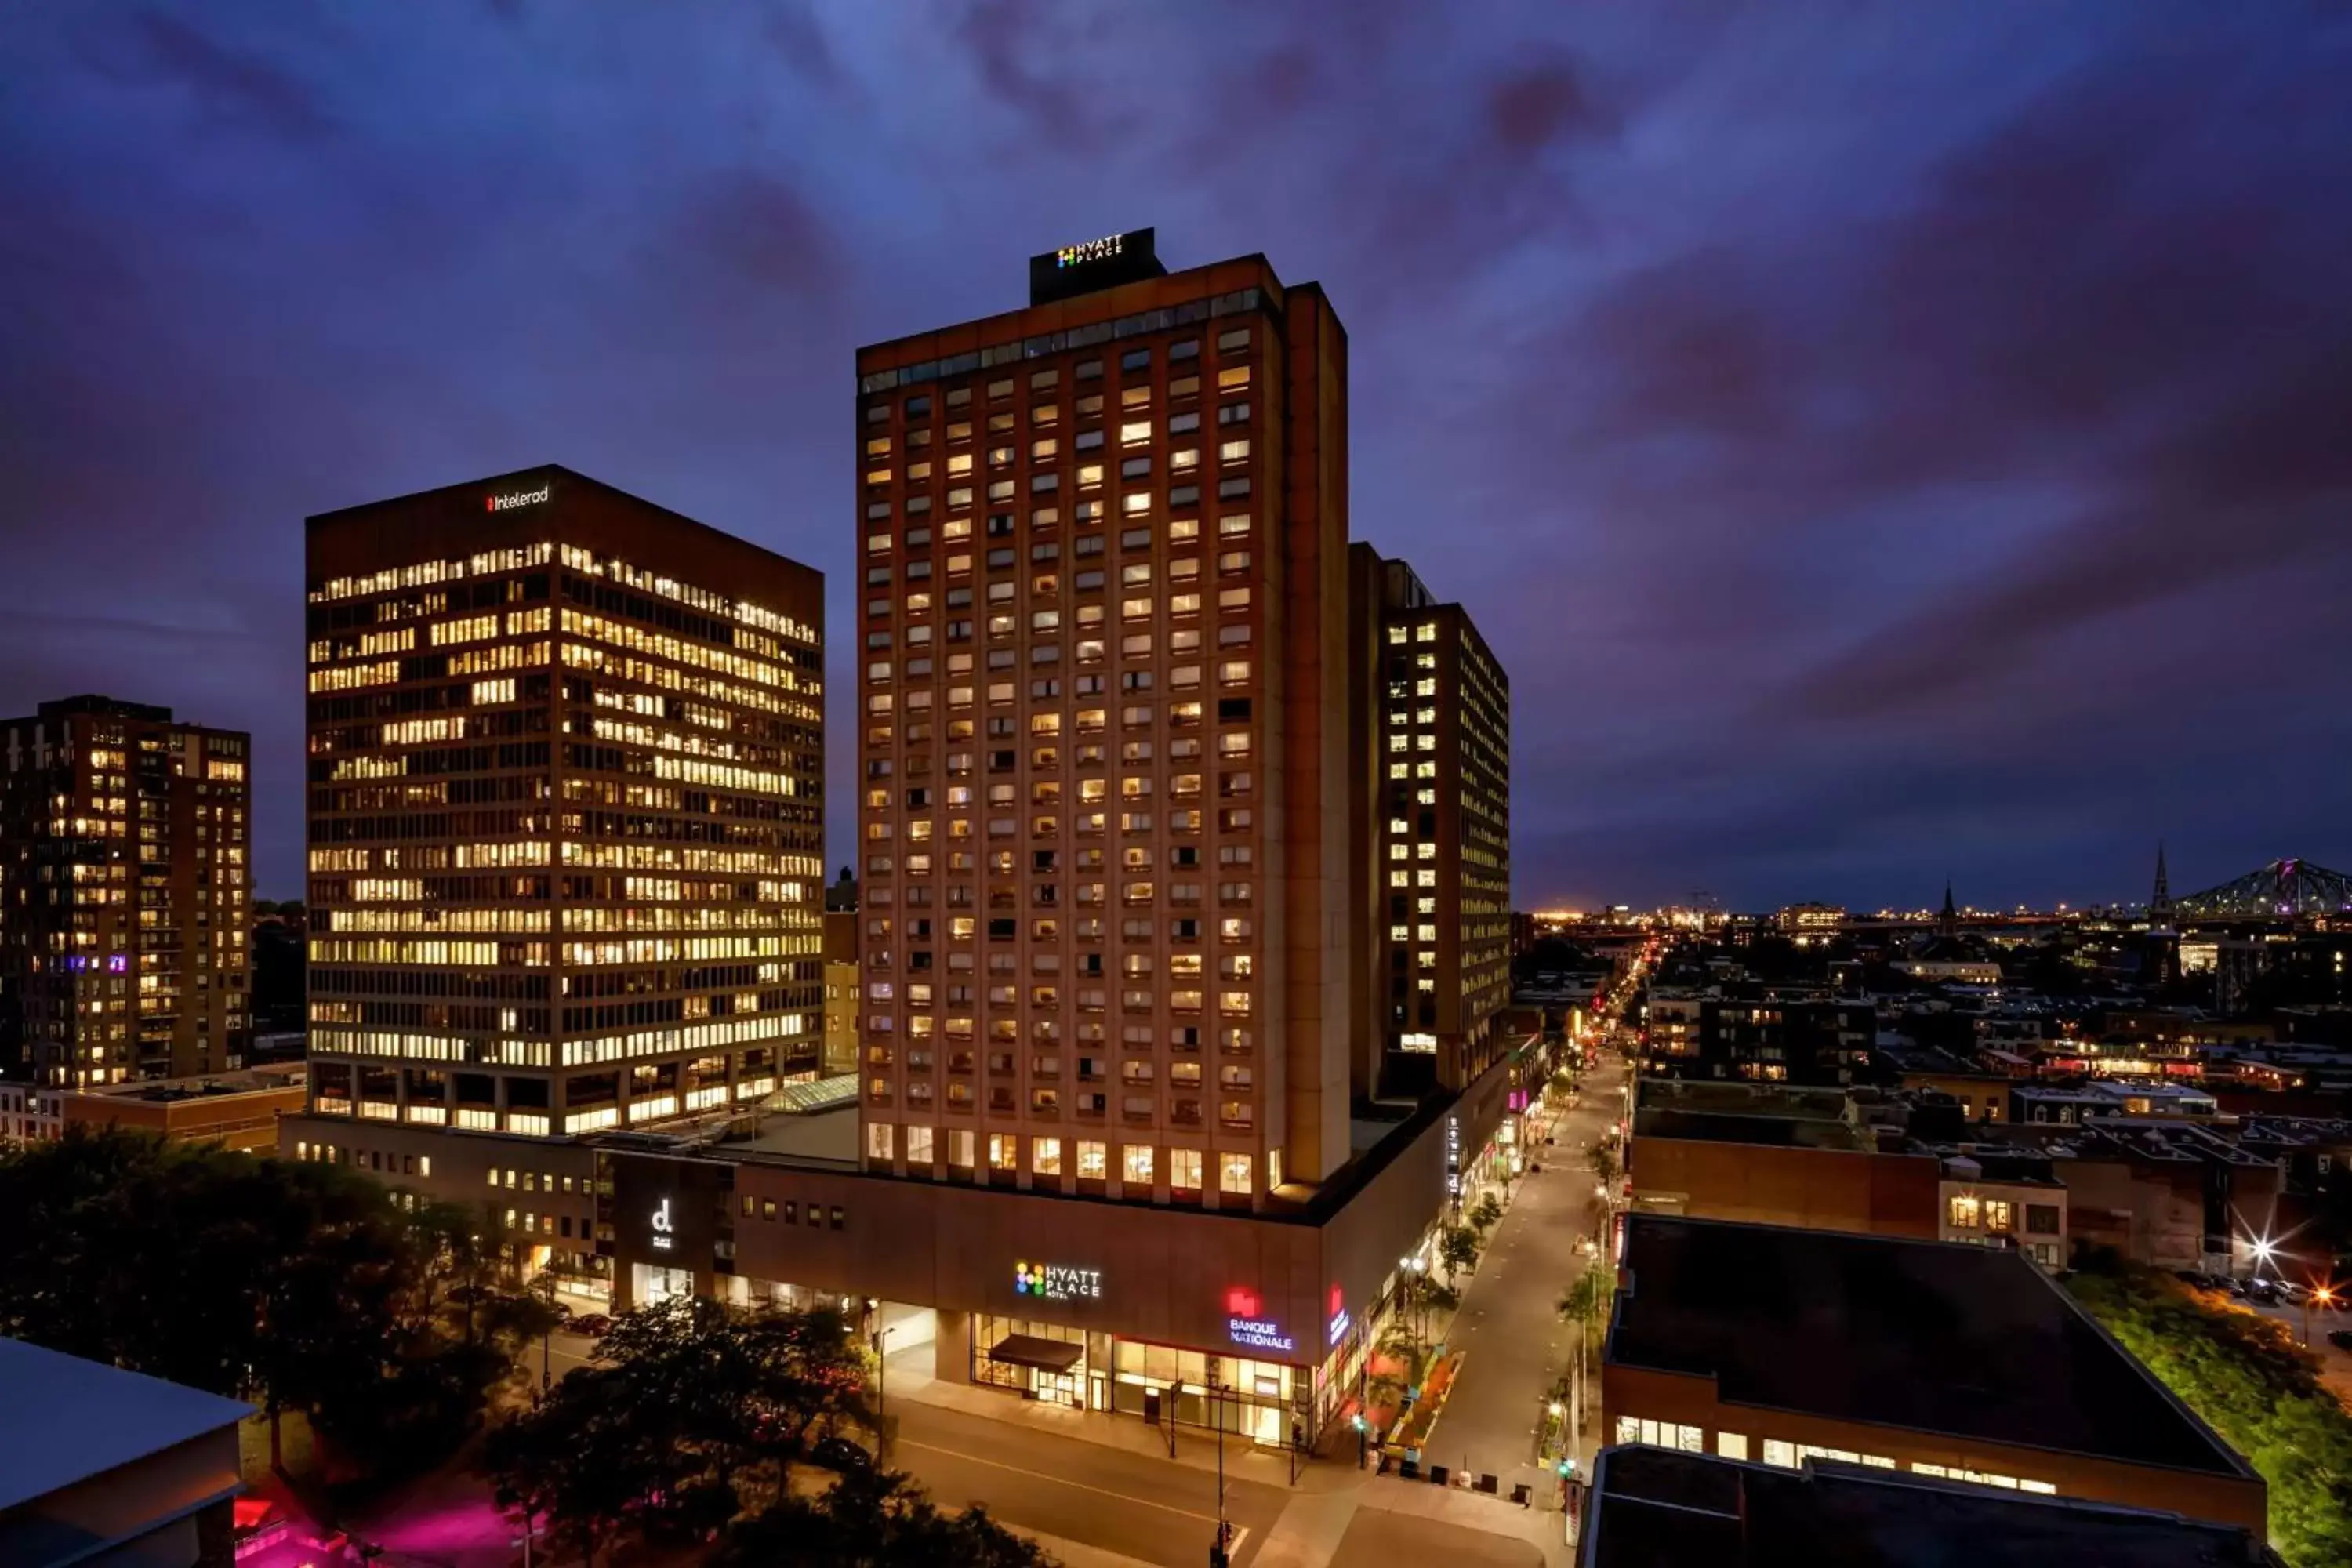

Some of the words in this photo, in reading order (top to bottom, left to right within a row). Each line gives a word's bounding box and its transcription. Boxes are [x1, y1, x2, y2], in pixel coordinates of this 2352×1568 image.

[1076, 234, 1122, 254] HYATT
[1076, 245, 1122, 263] PLACE
[1046, 1266, 1101, 1285] HYATT
[1046, 1280, 1100, 1298] PLACE
[1230, 1319, 1276, 1334] BANQUE
[1230, 1331, 1293, 1349] NATIONALE
